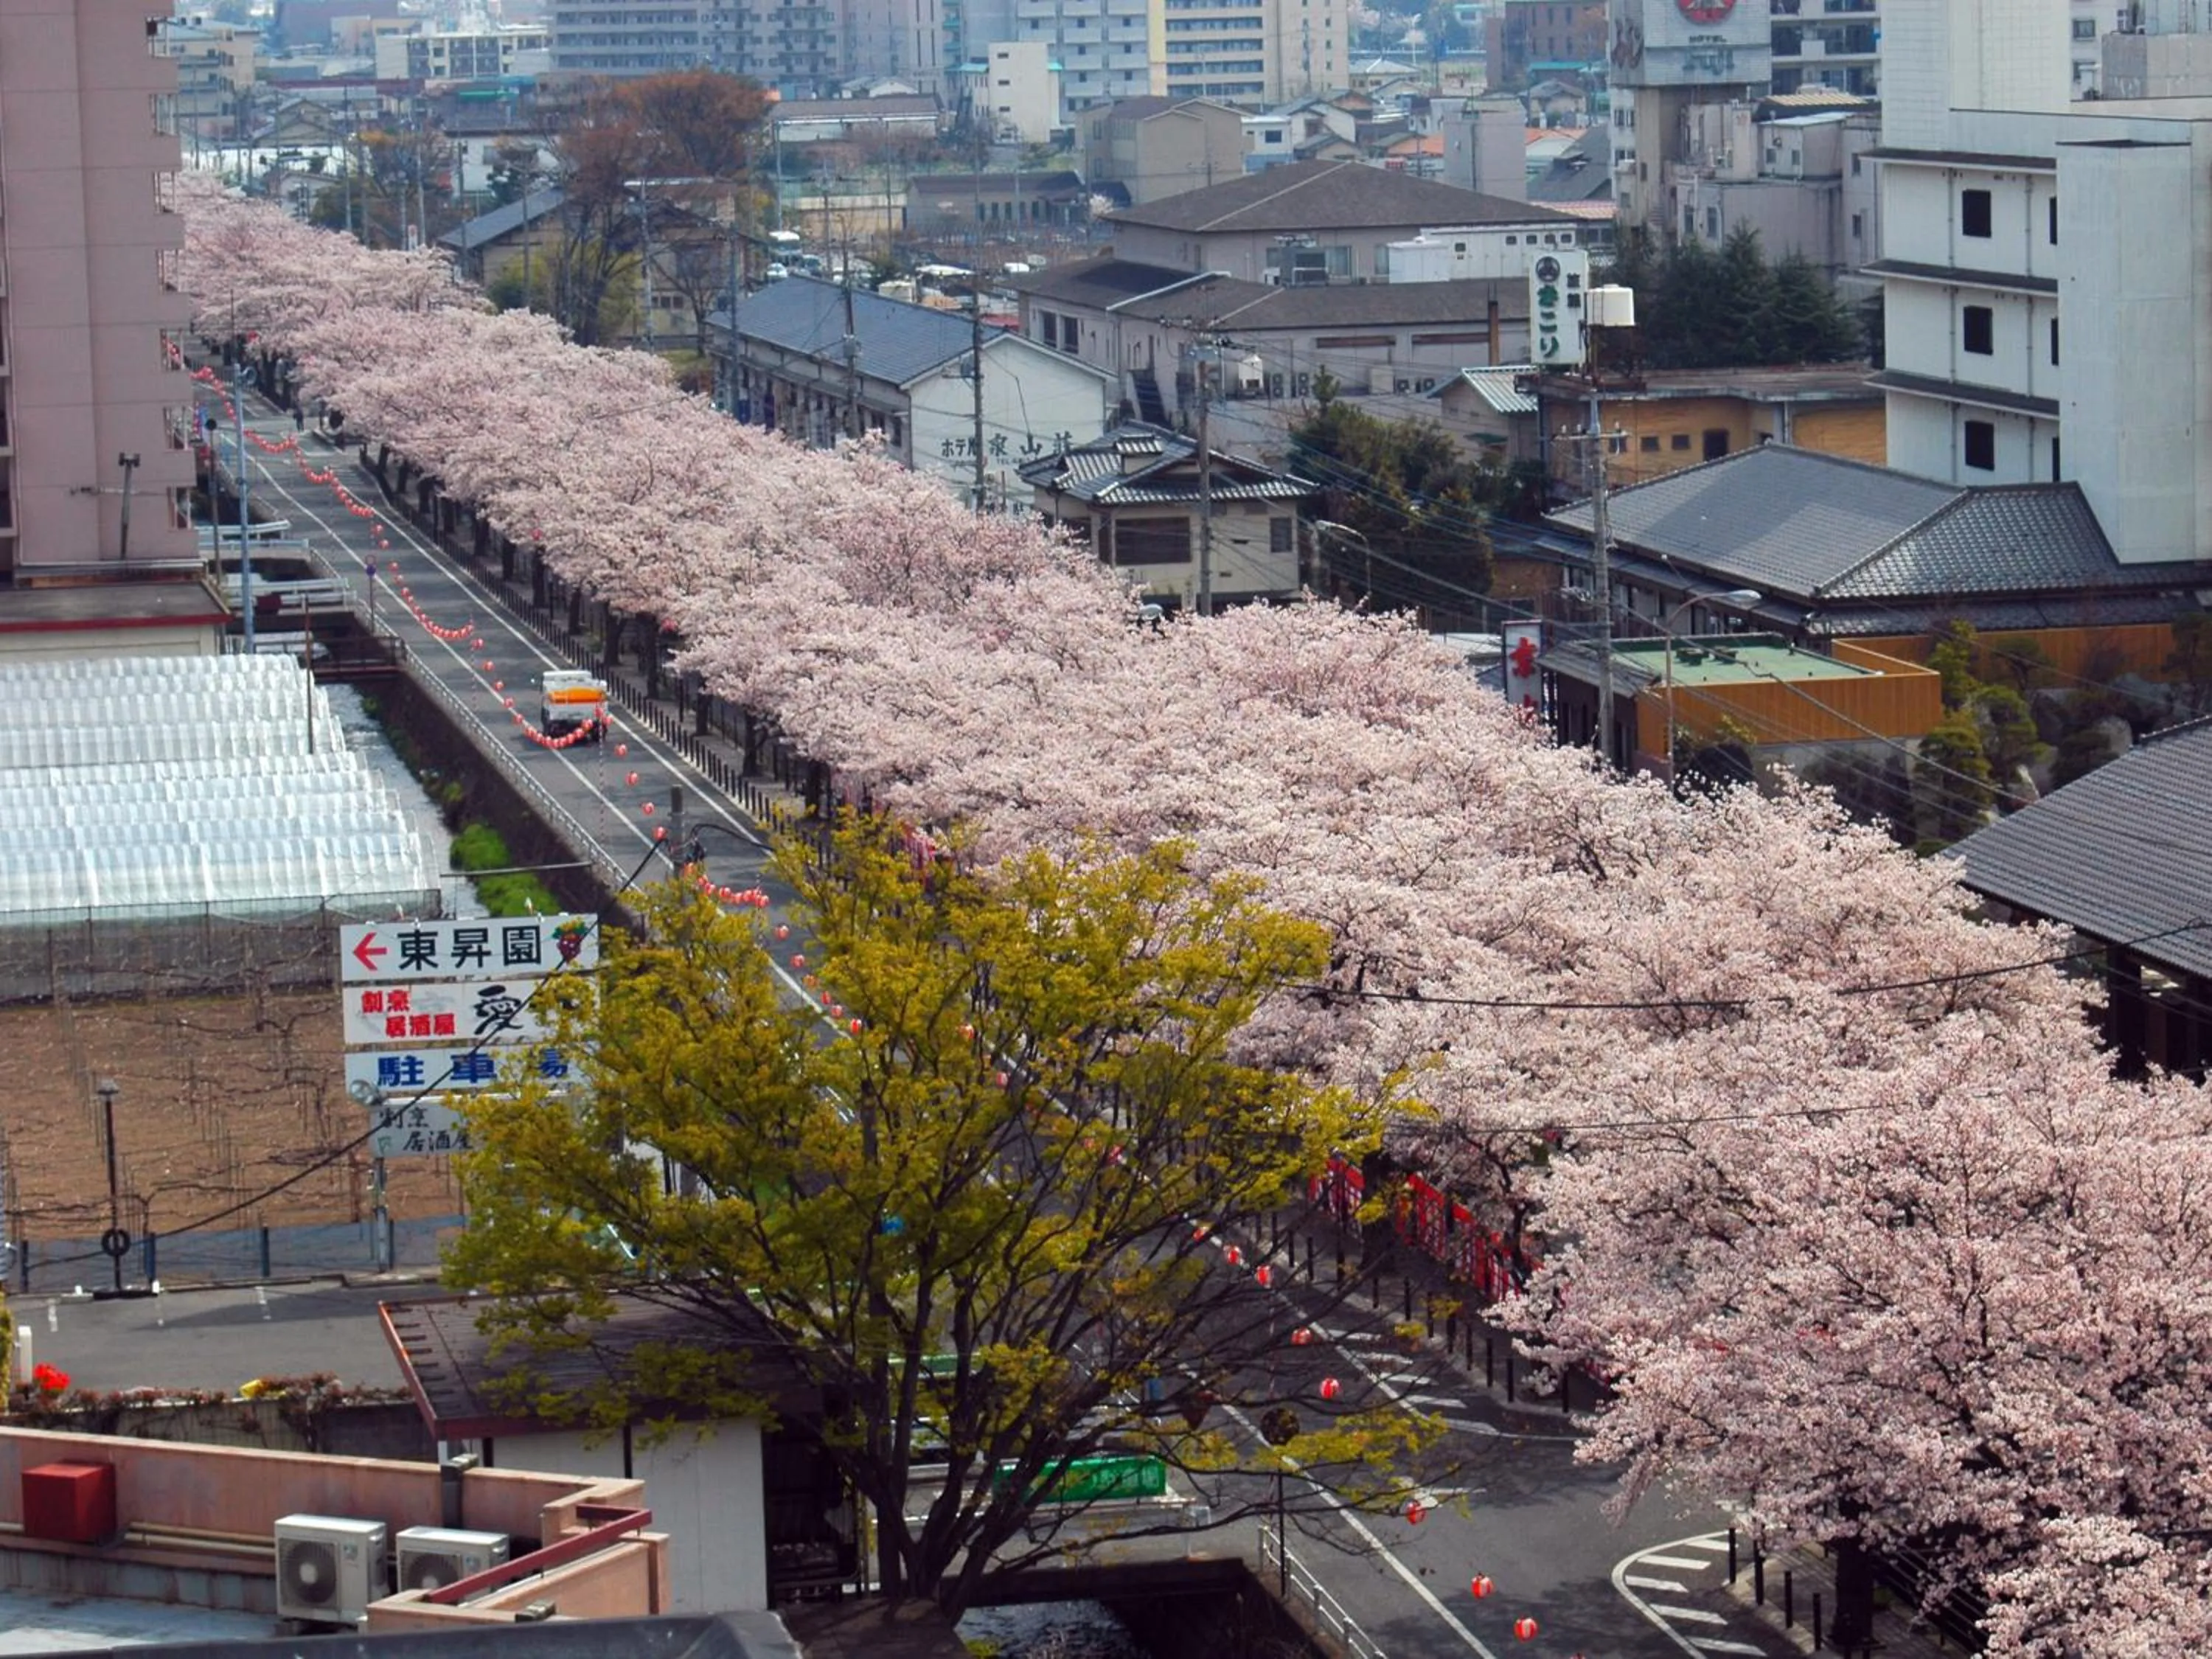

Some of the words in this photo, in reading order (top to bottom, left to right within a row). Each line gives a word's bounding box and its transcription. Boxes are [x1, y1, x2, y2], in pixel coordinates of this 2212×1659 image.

[397, 925, 542, 971] 東昇園
[386, 1013, 456, 1038] 居酒屋
[403, 1130, 473, 1152] 居酒屋
